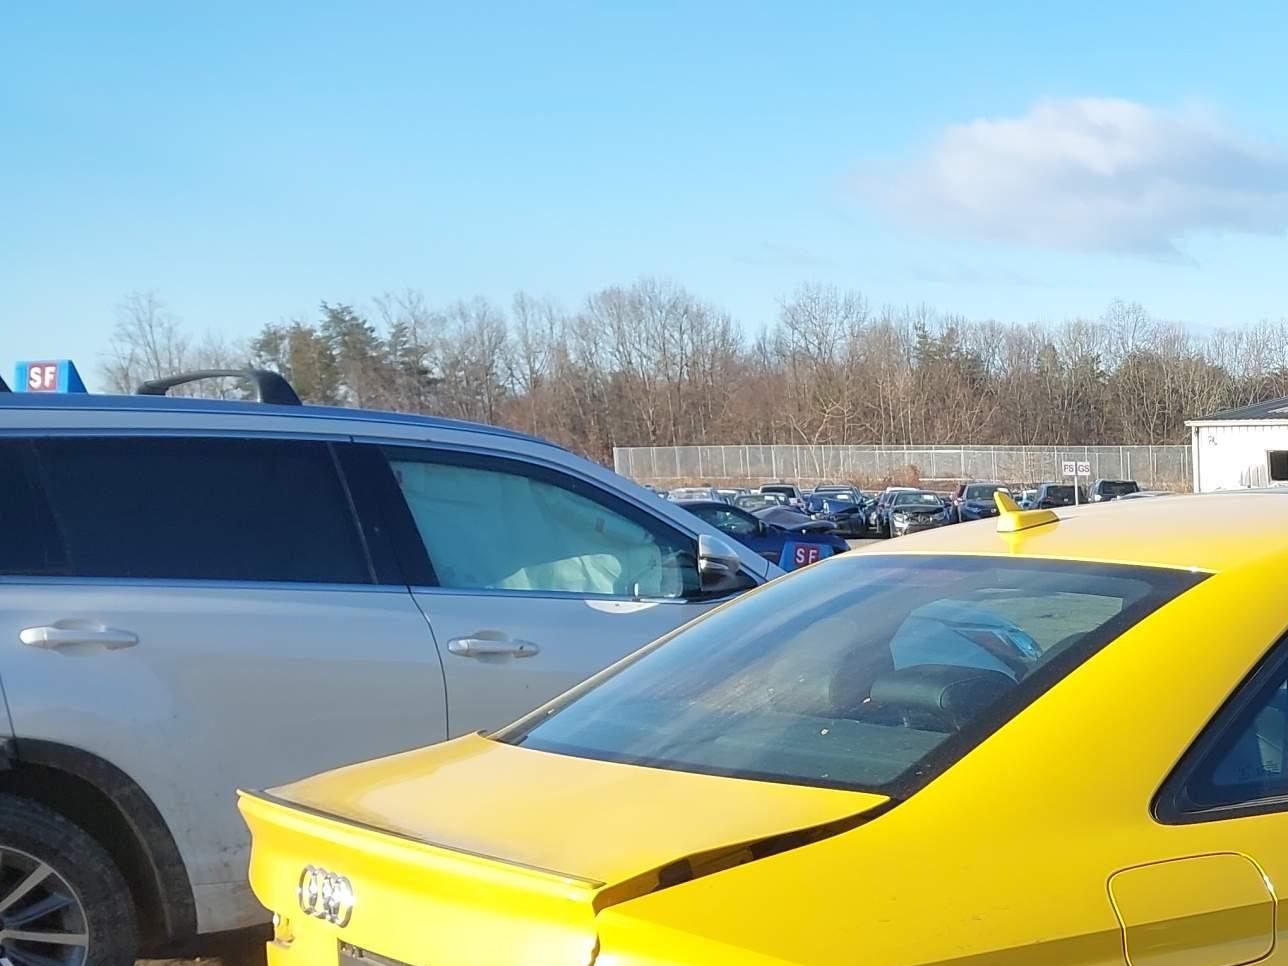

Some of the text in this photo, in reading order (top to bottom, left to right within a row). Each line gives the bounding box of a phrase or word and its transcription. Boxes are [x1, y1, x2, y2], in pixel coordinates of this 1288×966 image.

[29, 366, 57, 389] SF
[1077, 464, 1090, 473] GS
[795, 547, 818, 564] SF
